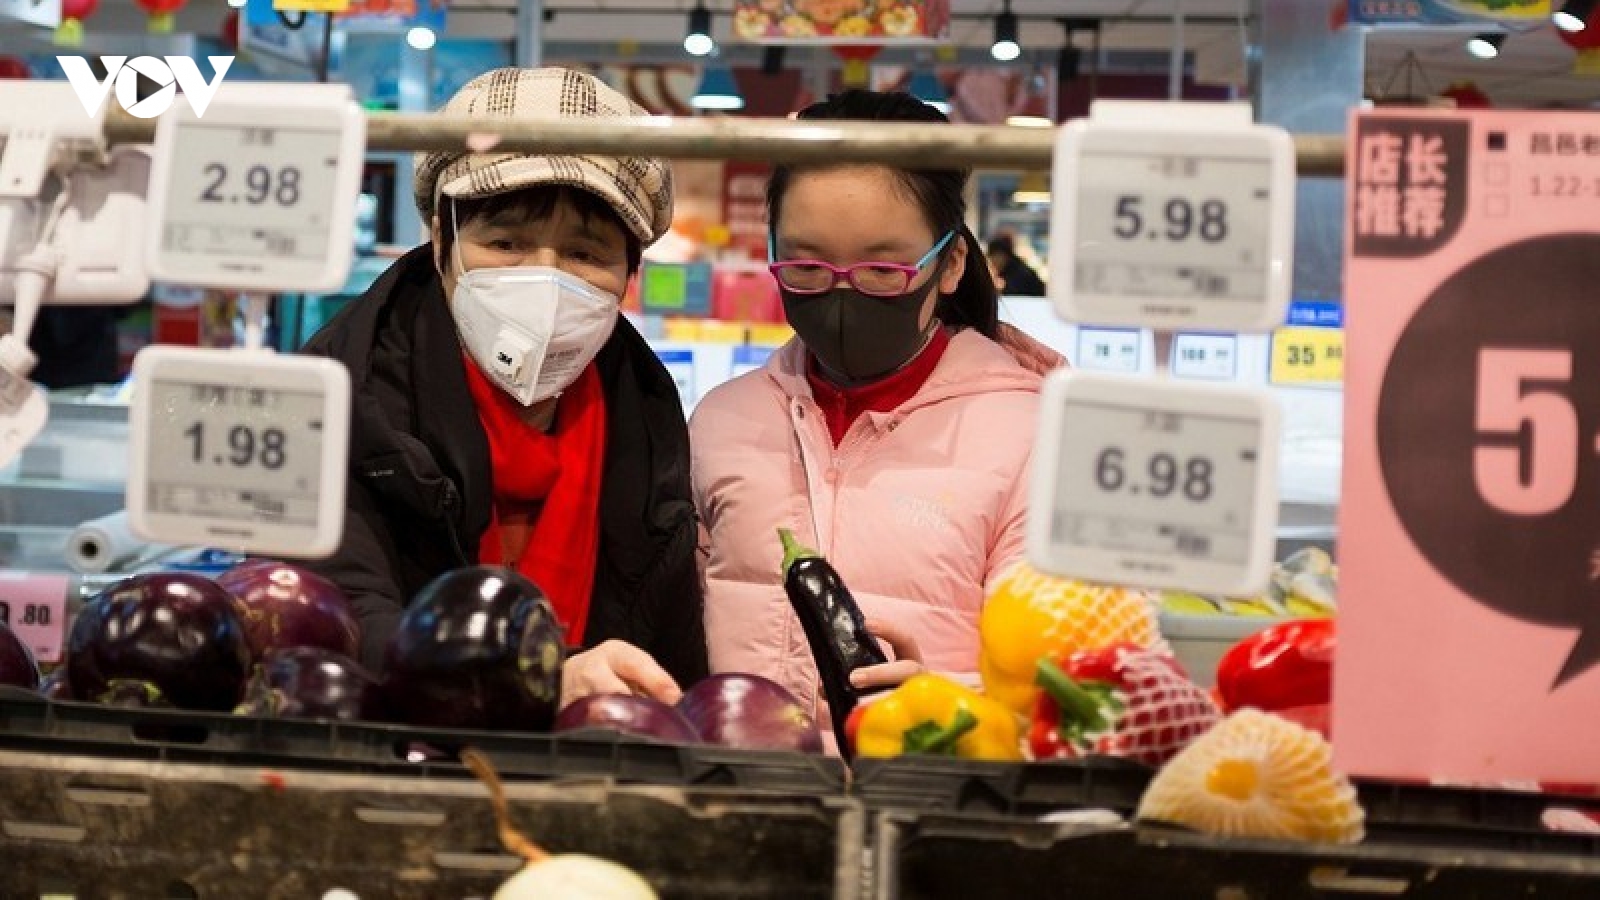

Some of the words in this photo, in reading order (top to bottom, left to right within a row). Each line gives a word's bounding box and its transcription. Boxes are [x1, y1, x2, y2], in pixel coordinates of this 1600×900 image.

[1359, 132, 1449, 184] 店长
[200, 164, 302, 207] 2.98
[1113, 195, 1228, 243] 5.98
[184, 421, 286, 470] 1.98
[1095, 446, 1214, 502] 6.98
